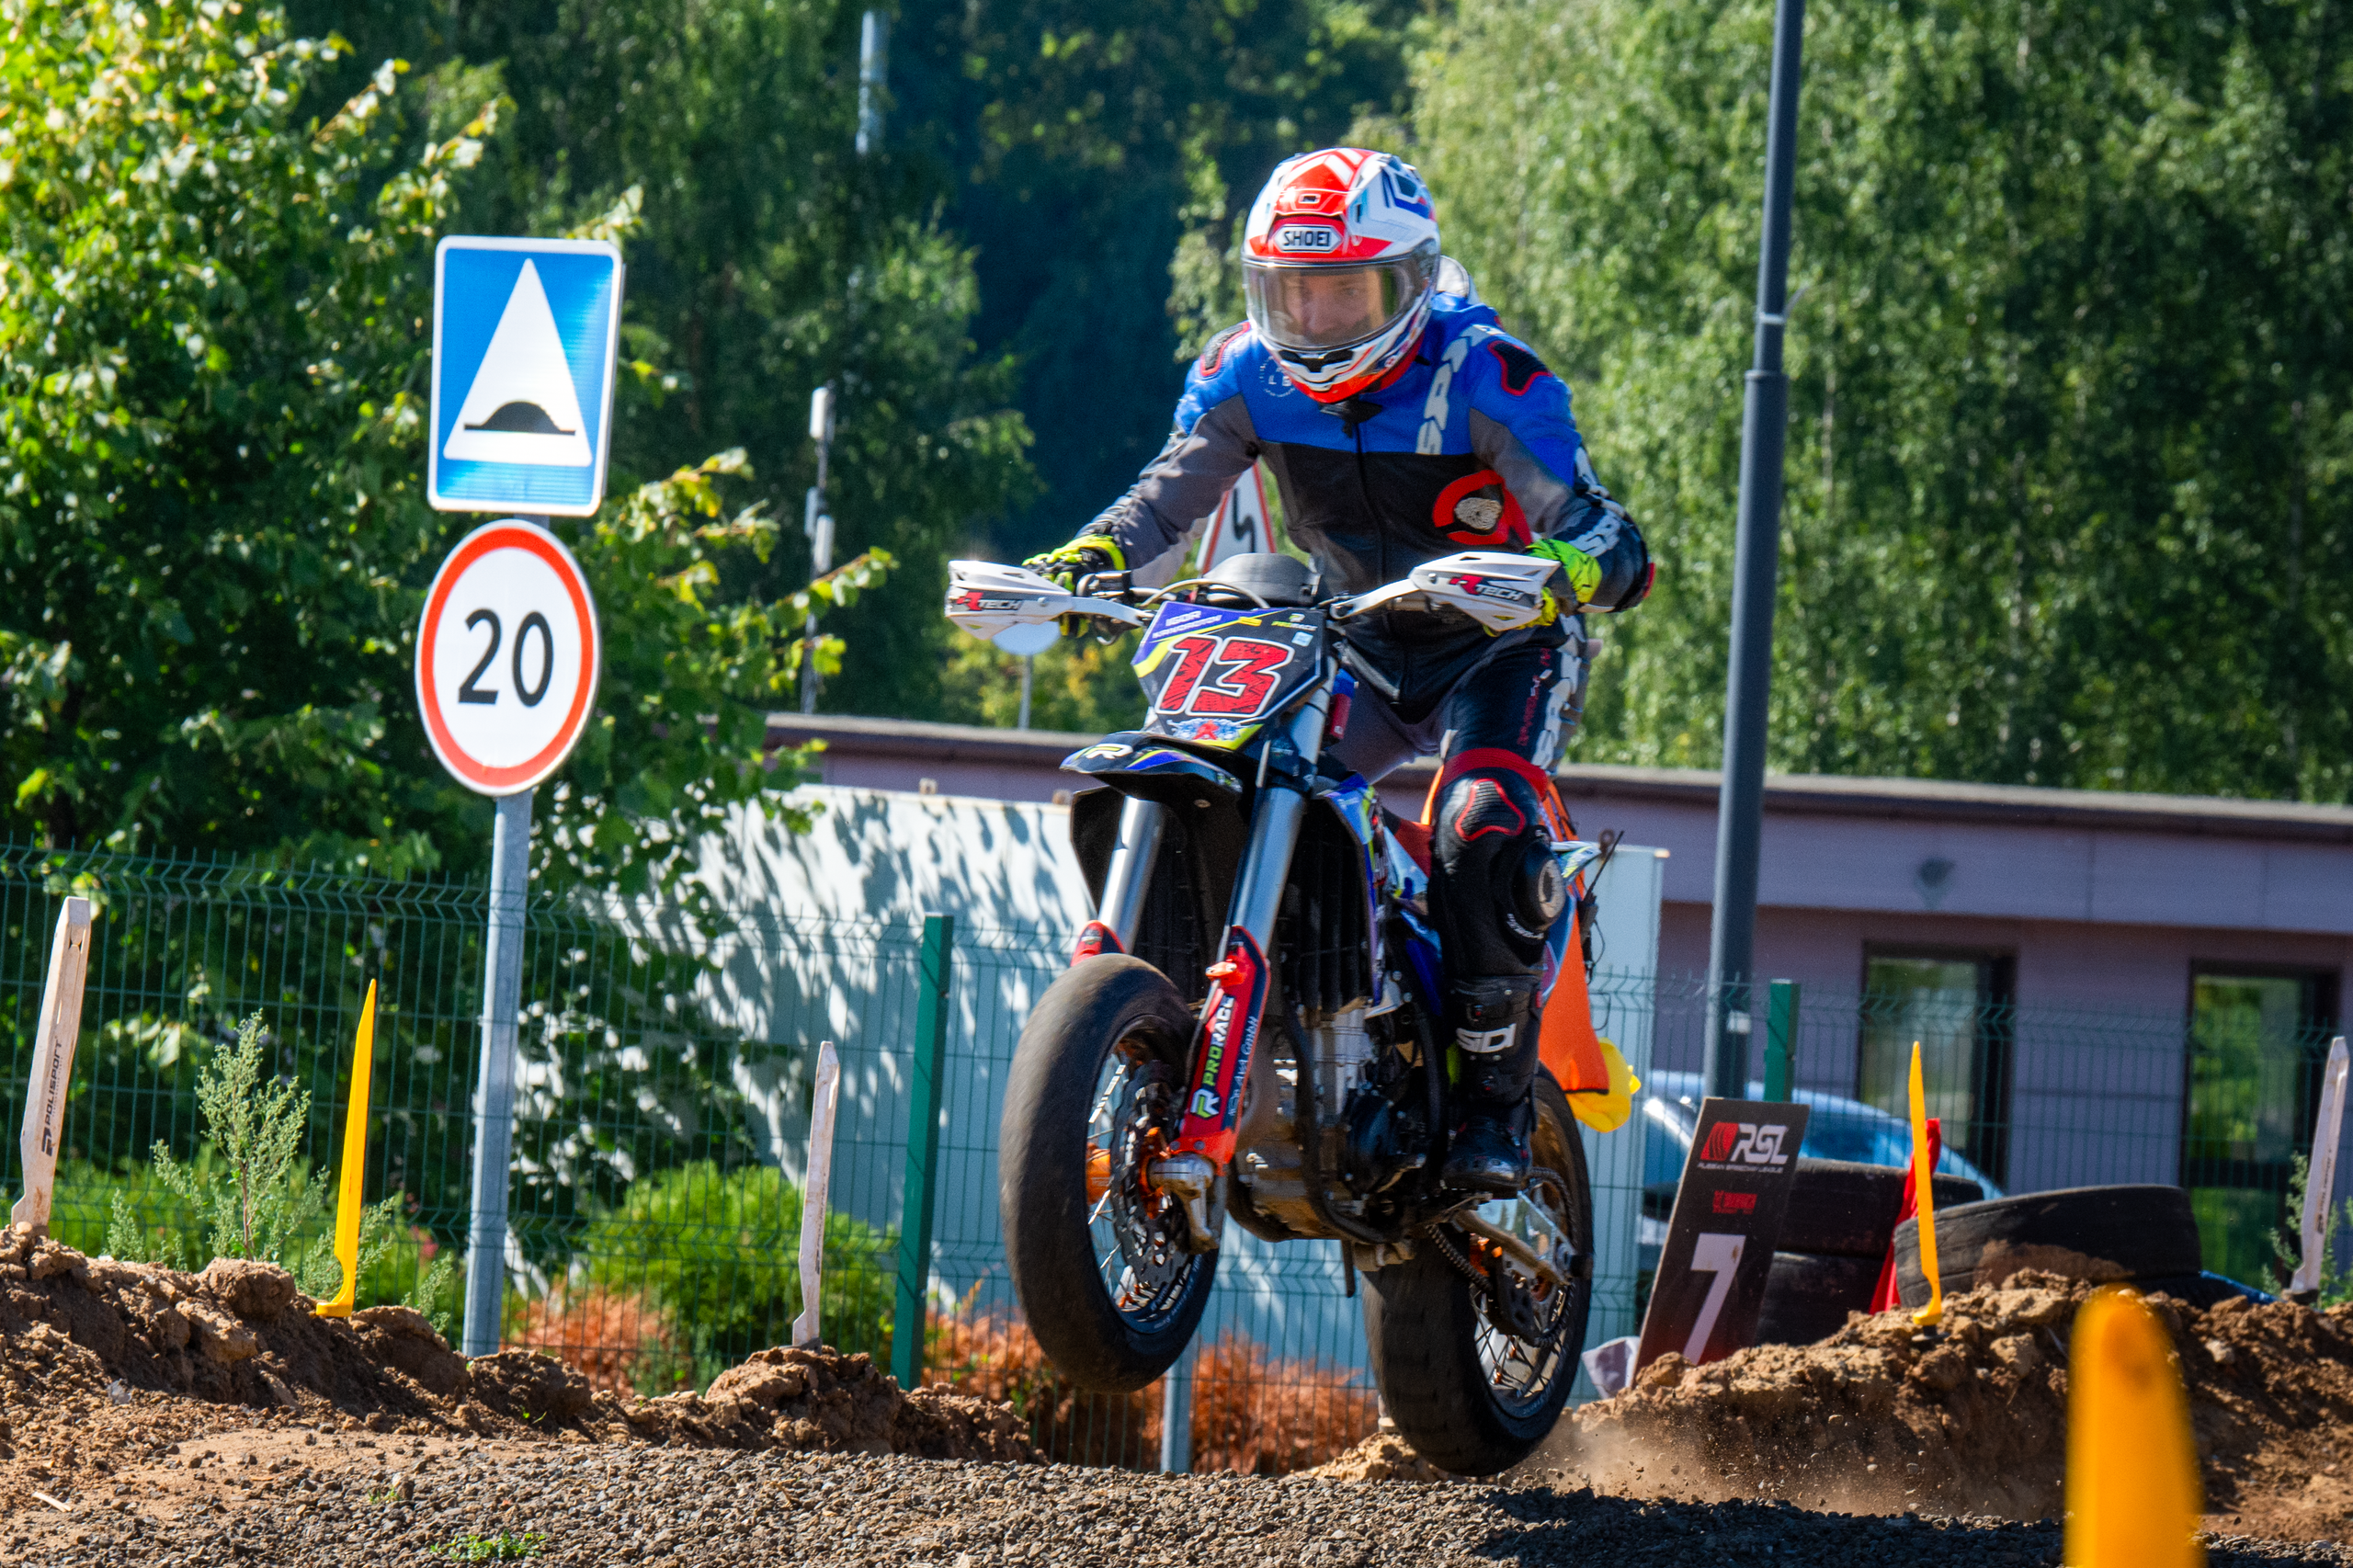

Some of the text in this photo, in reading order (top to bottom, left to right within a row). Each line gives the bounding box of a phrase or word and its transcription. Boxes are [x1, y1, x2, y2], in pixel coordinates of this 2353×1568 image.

[1283, 231, 1331, 247] SHOEI
[458, 608, 554, 709] 20
[1154, 633, 1295, 717] 13
[45, 1040, 63, 1126] POLISPORT
[1683, 1233, 1746, 1366] 7
